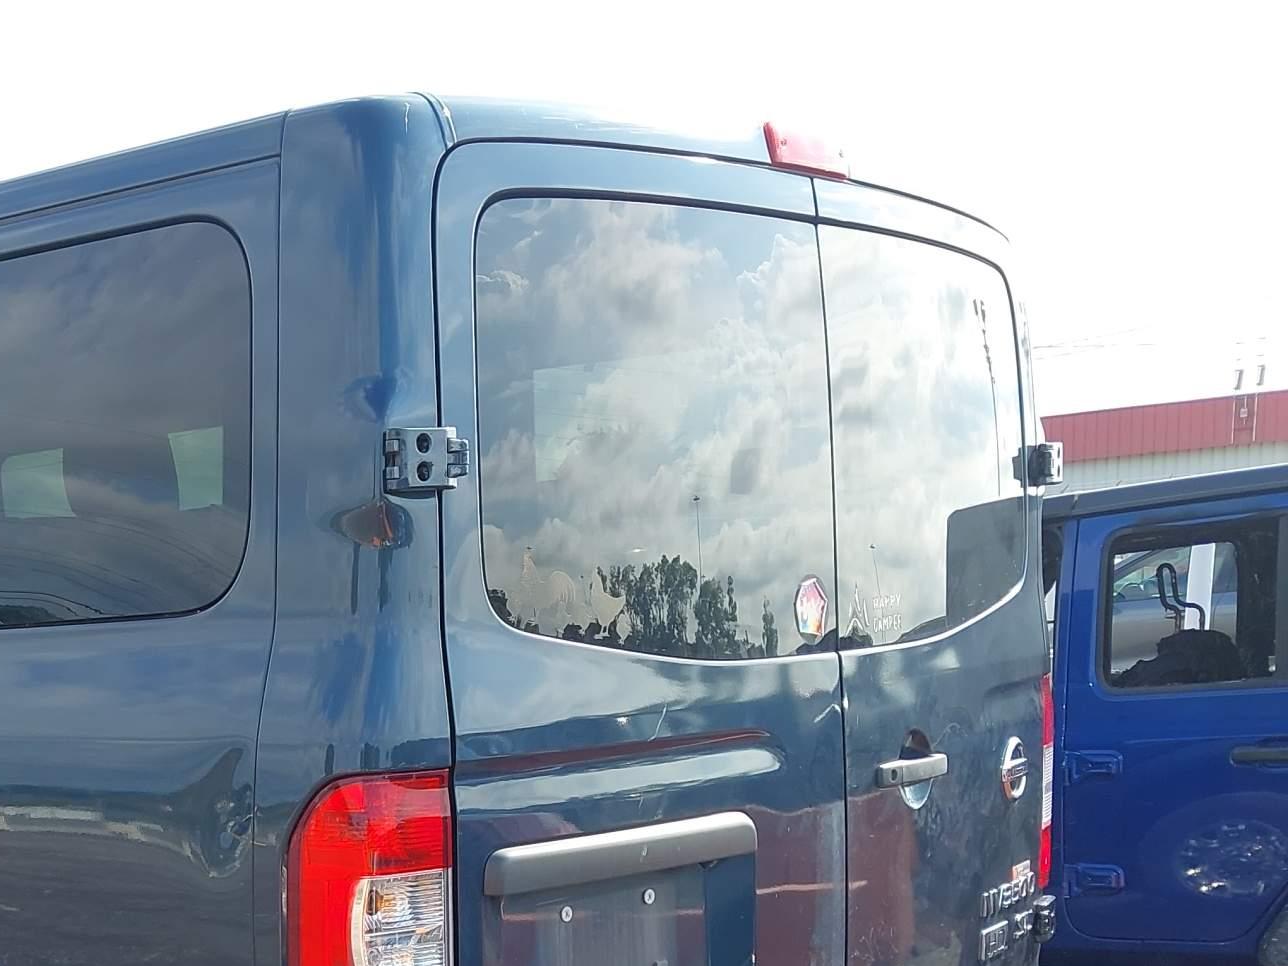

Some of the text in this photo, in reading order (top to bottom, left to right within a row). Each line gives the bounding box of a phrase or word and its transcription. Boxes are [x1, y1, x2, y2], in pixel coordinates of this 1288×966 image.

[873, 593, 901, 609] HAPPY
[873, 612, 901, 632] CAMPER
[978, 920, 1008, 960] HD
